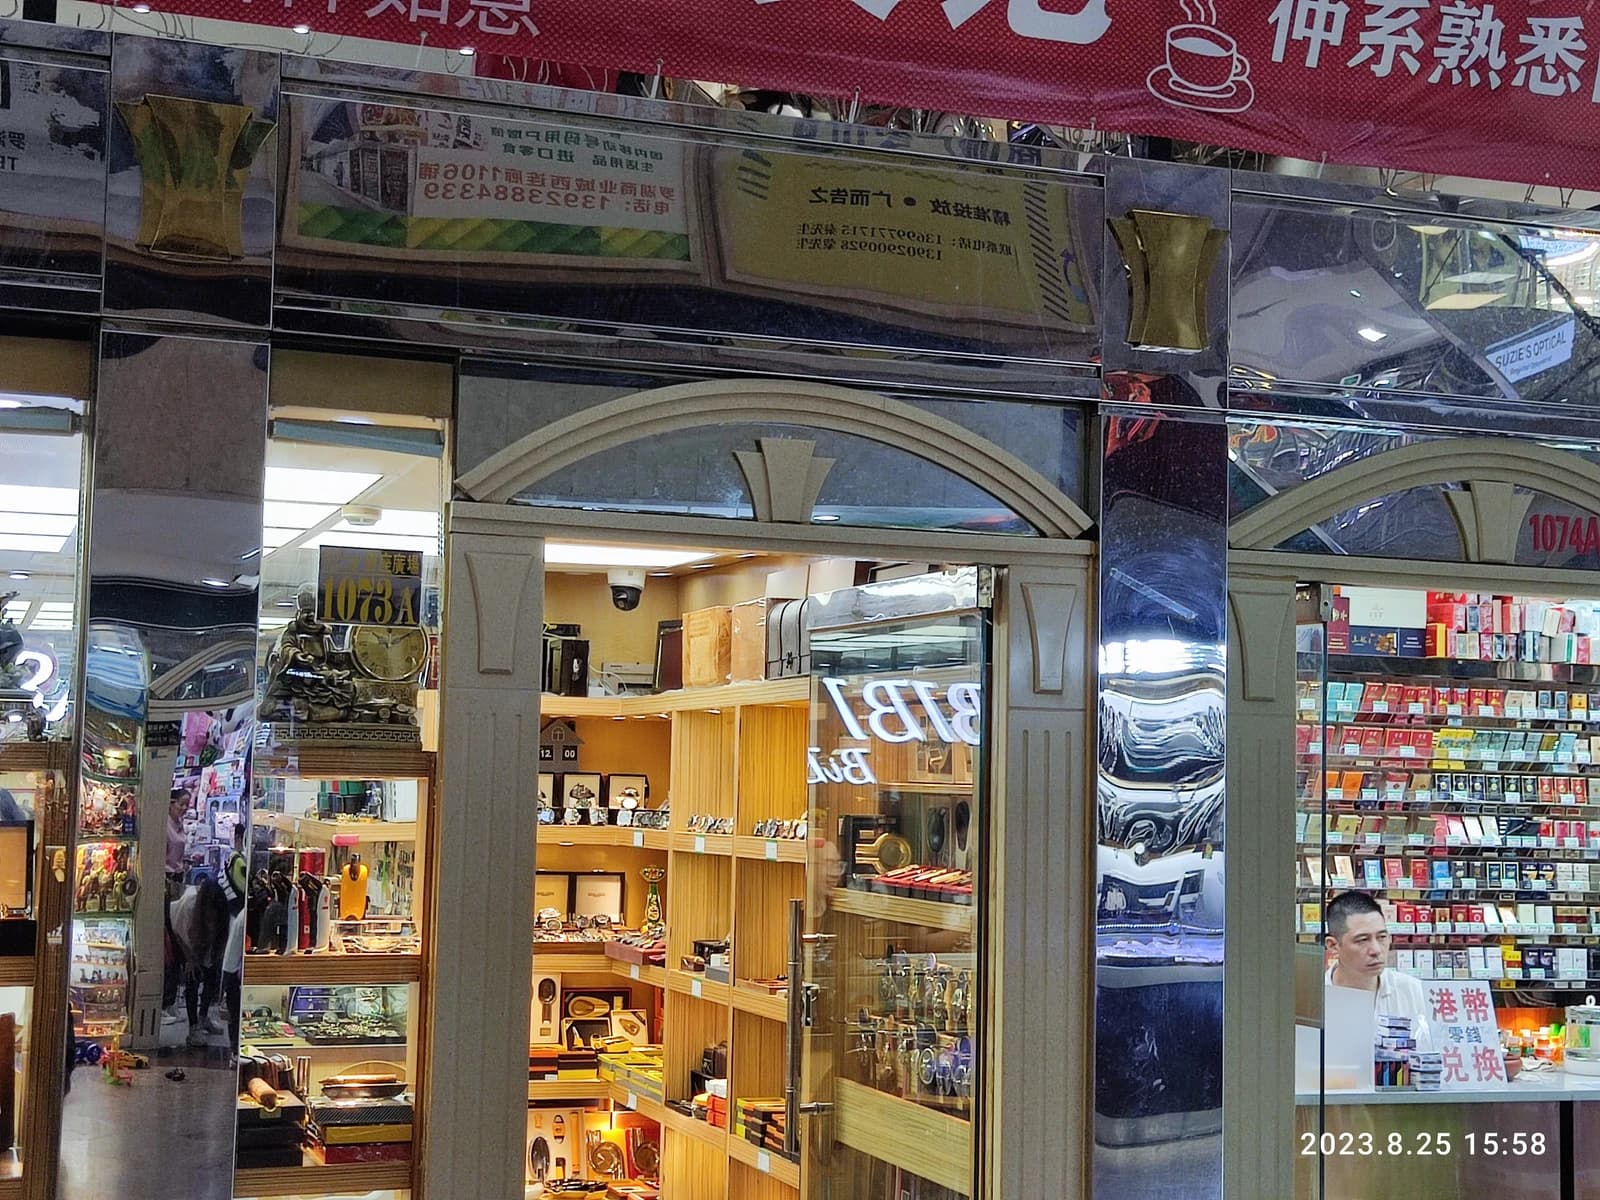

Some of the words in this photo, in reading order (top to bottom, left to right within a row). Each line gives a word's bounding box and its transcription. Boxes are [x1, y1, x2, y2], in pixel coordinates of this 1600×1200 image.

[1267, 0, 1600, 103] 仲系熟悉
[1495, 344, 1532, 368] SUZIE'S
[1533, 330, 1567, 357] OPTICAL
[1529, 513, 1600, 555] 1074A
[322, 575, 416, 625] 1073A
[540, 749, 552, 758] 12
[564, 749, 576, 758] 00
[1429, 987, 1490, 1024] 港幣
